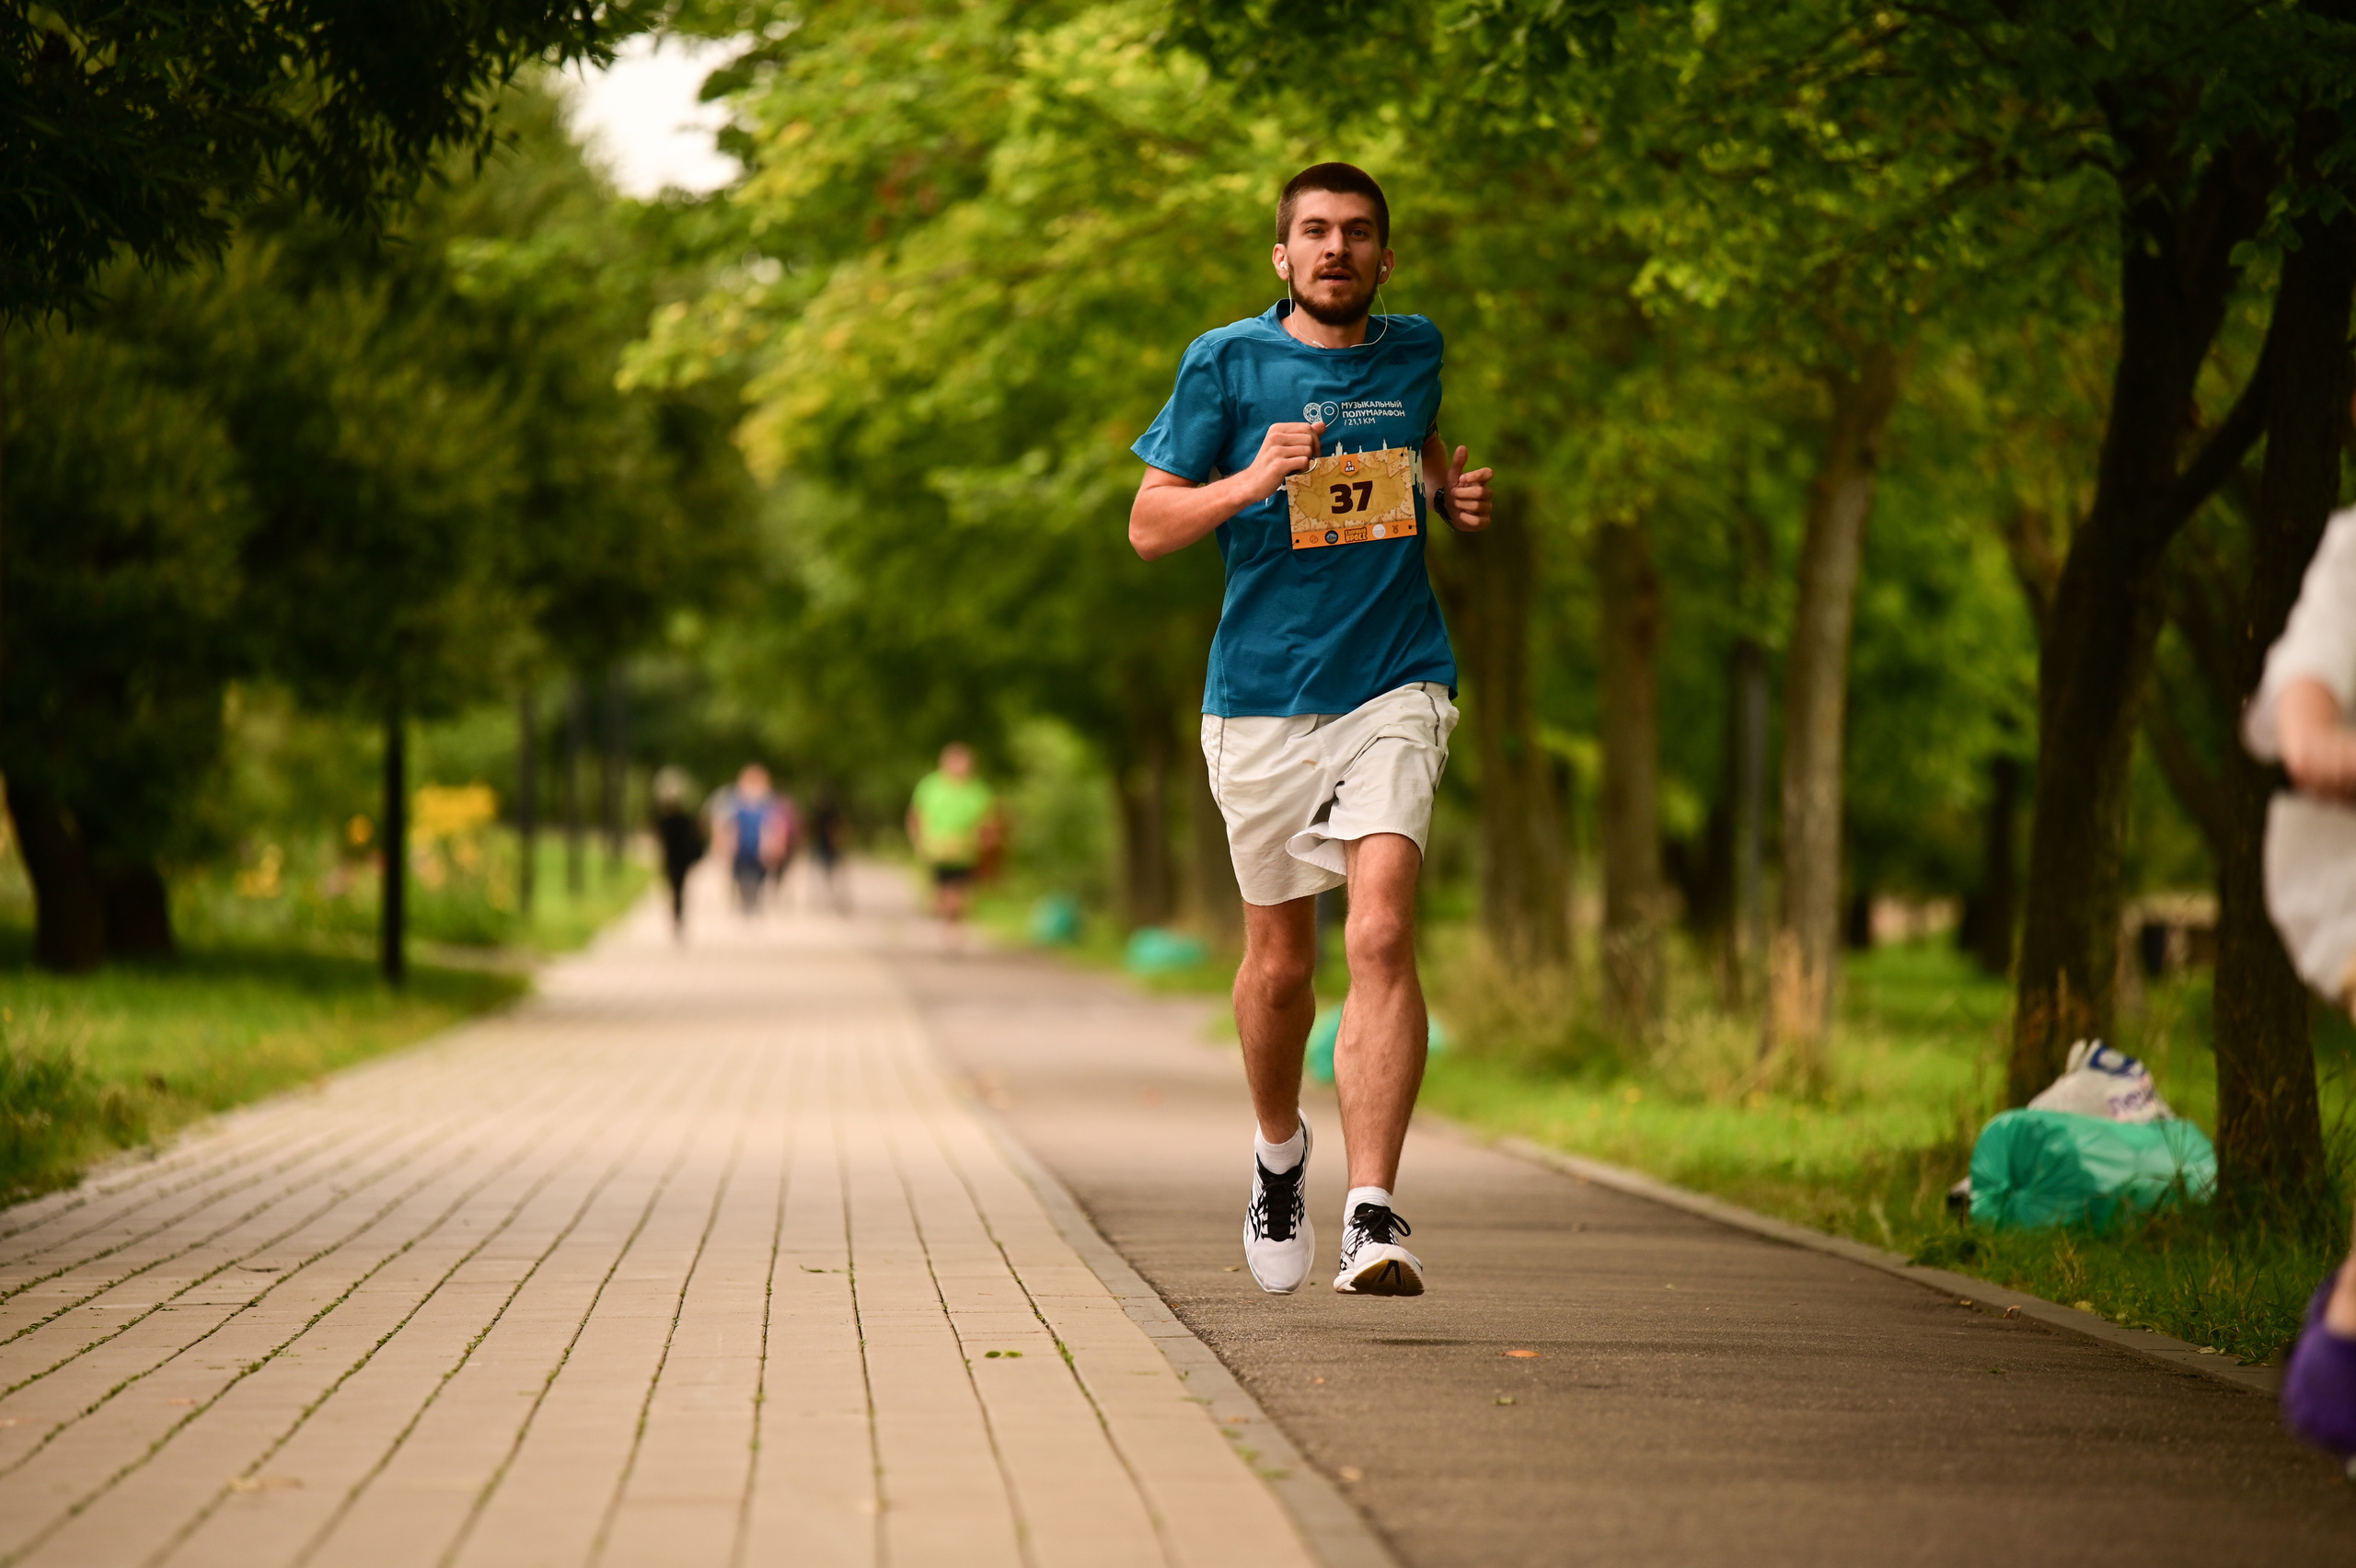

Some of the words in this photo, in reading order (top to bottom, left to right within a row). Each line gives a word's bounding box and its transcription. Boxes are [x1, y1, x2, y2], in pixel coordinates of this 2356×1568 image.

[1341, 399, 1403, 409] МУЗЫКАЛЬНЫЙ
[1342, 409, 1405, 419] ПОЛУМАРАФОН
[1363, 417, 1376, 425] КМ
[1330, 480, 1373, 514] 37
